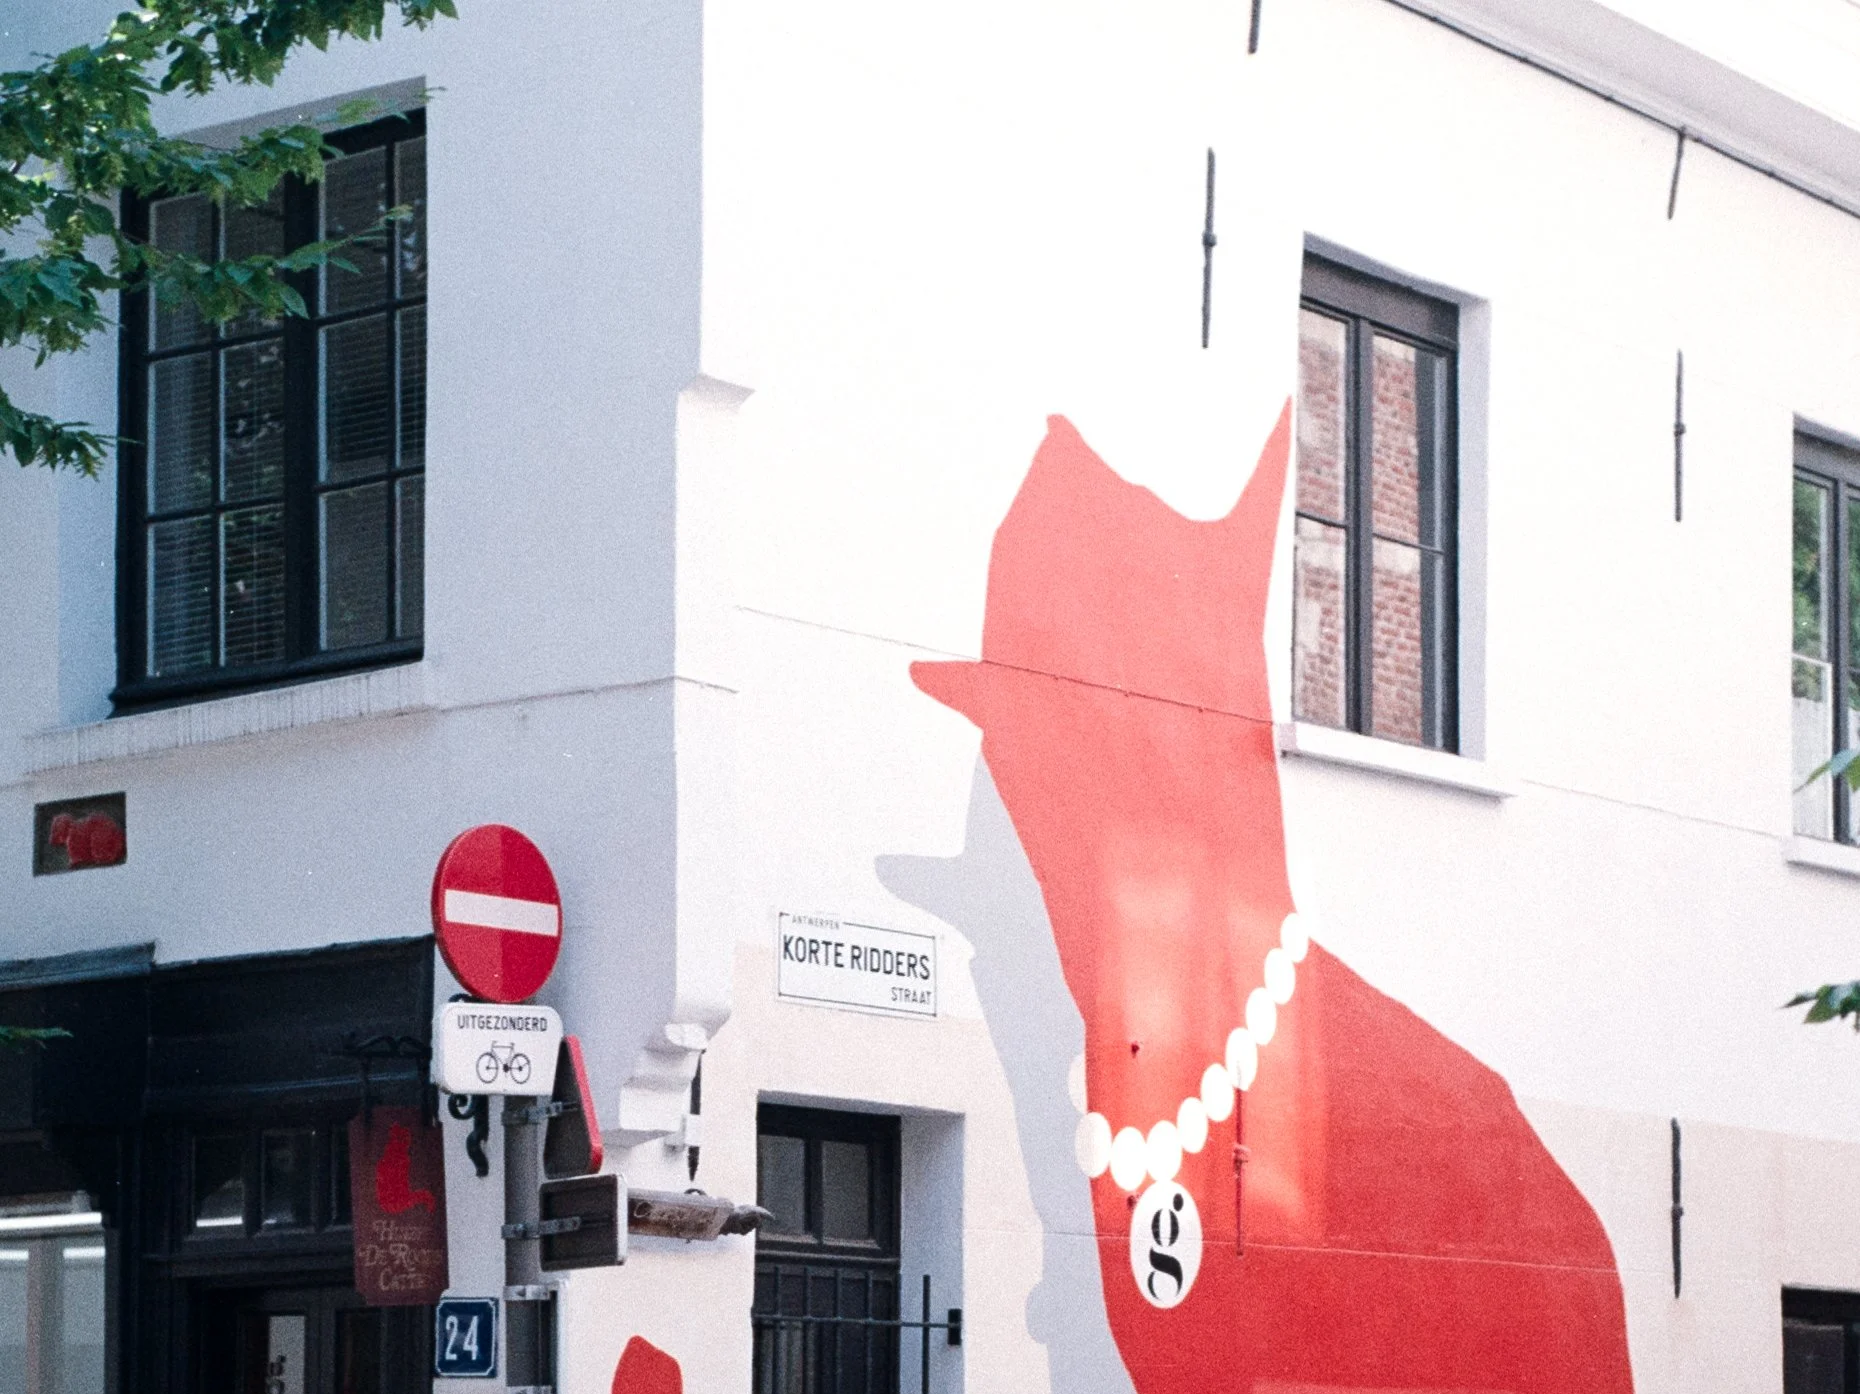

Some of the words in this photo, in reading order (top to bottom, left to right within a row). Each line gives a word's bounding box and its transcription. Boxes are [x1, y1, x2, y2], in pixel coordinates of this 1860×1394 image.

[792, 914, 840, 930] ANTWERPEN
[783, 934, 845, 969] KORTE
[850, 945, 930, 980] RIDDERS
[891, 985, 932, 1005] STRAAT
[457, 1014, 548, 1032] UITGEZONDERD
[445, 1315, 479, 1360] 24
